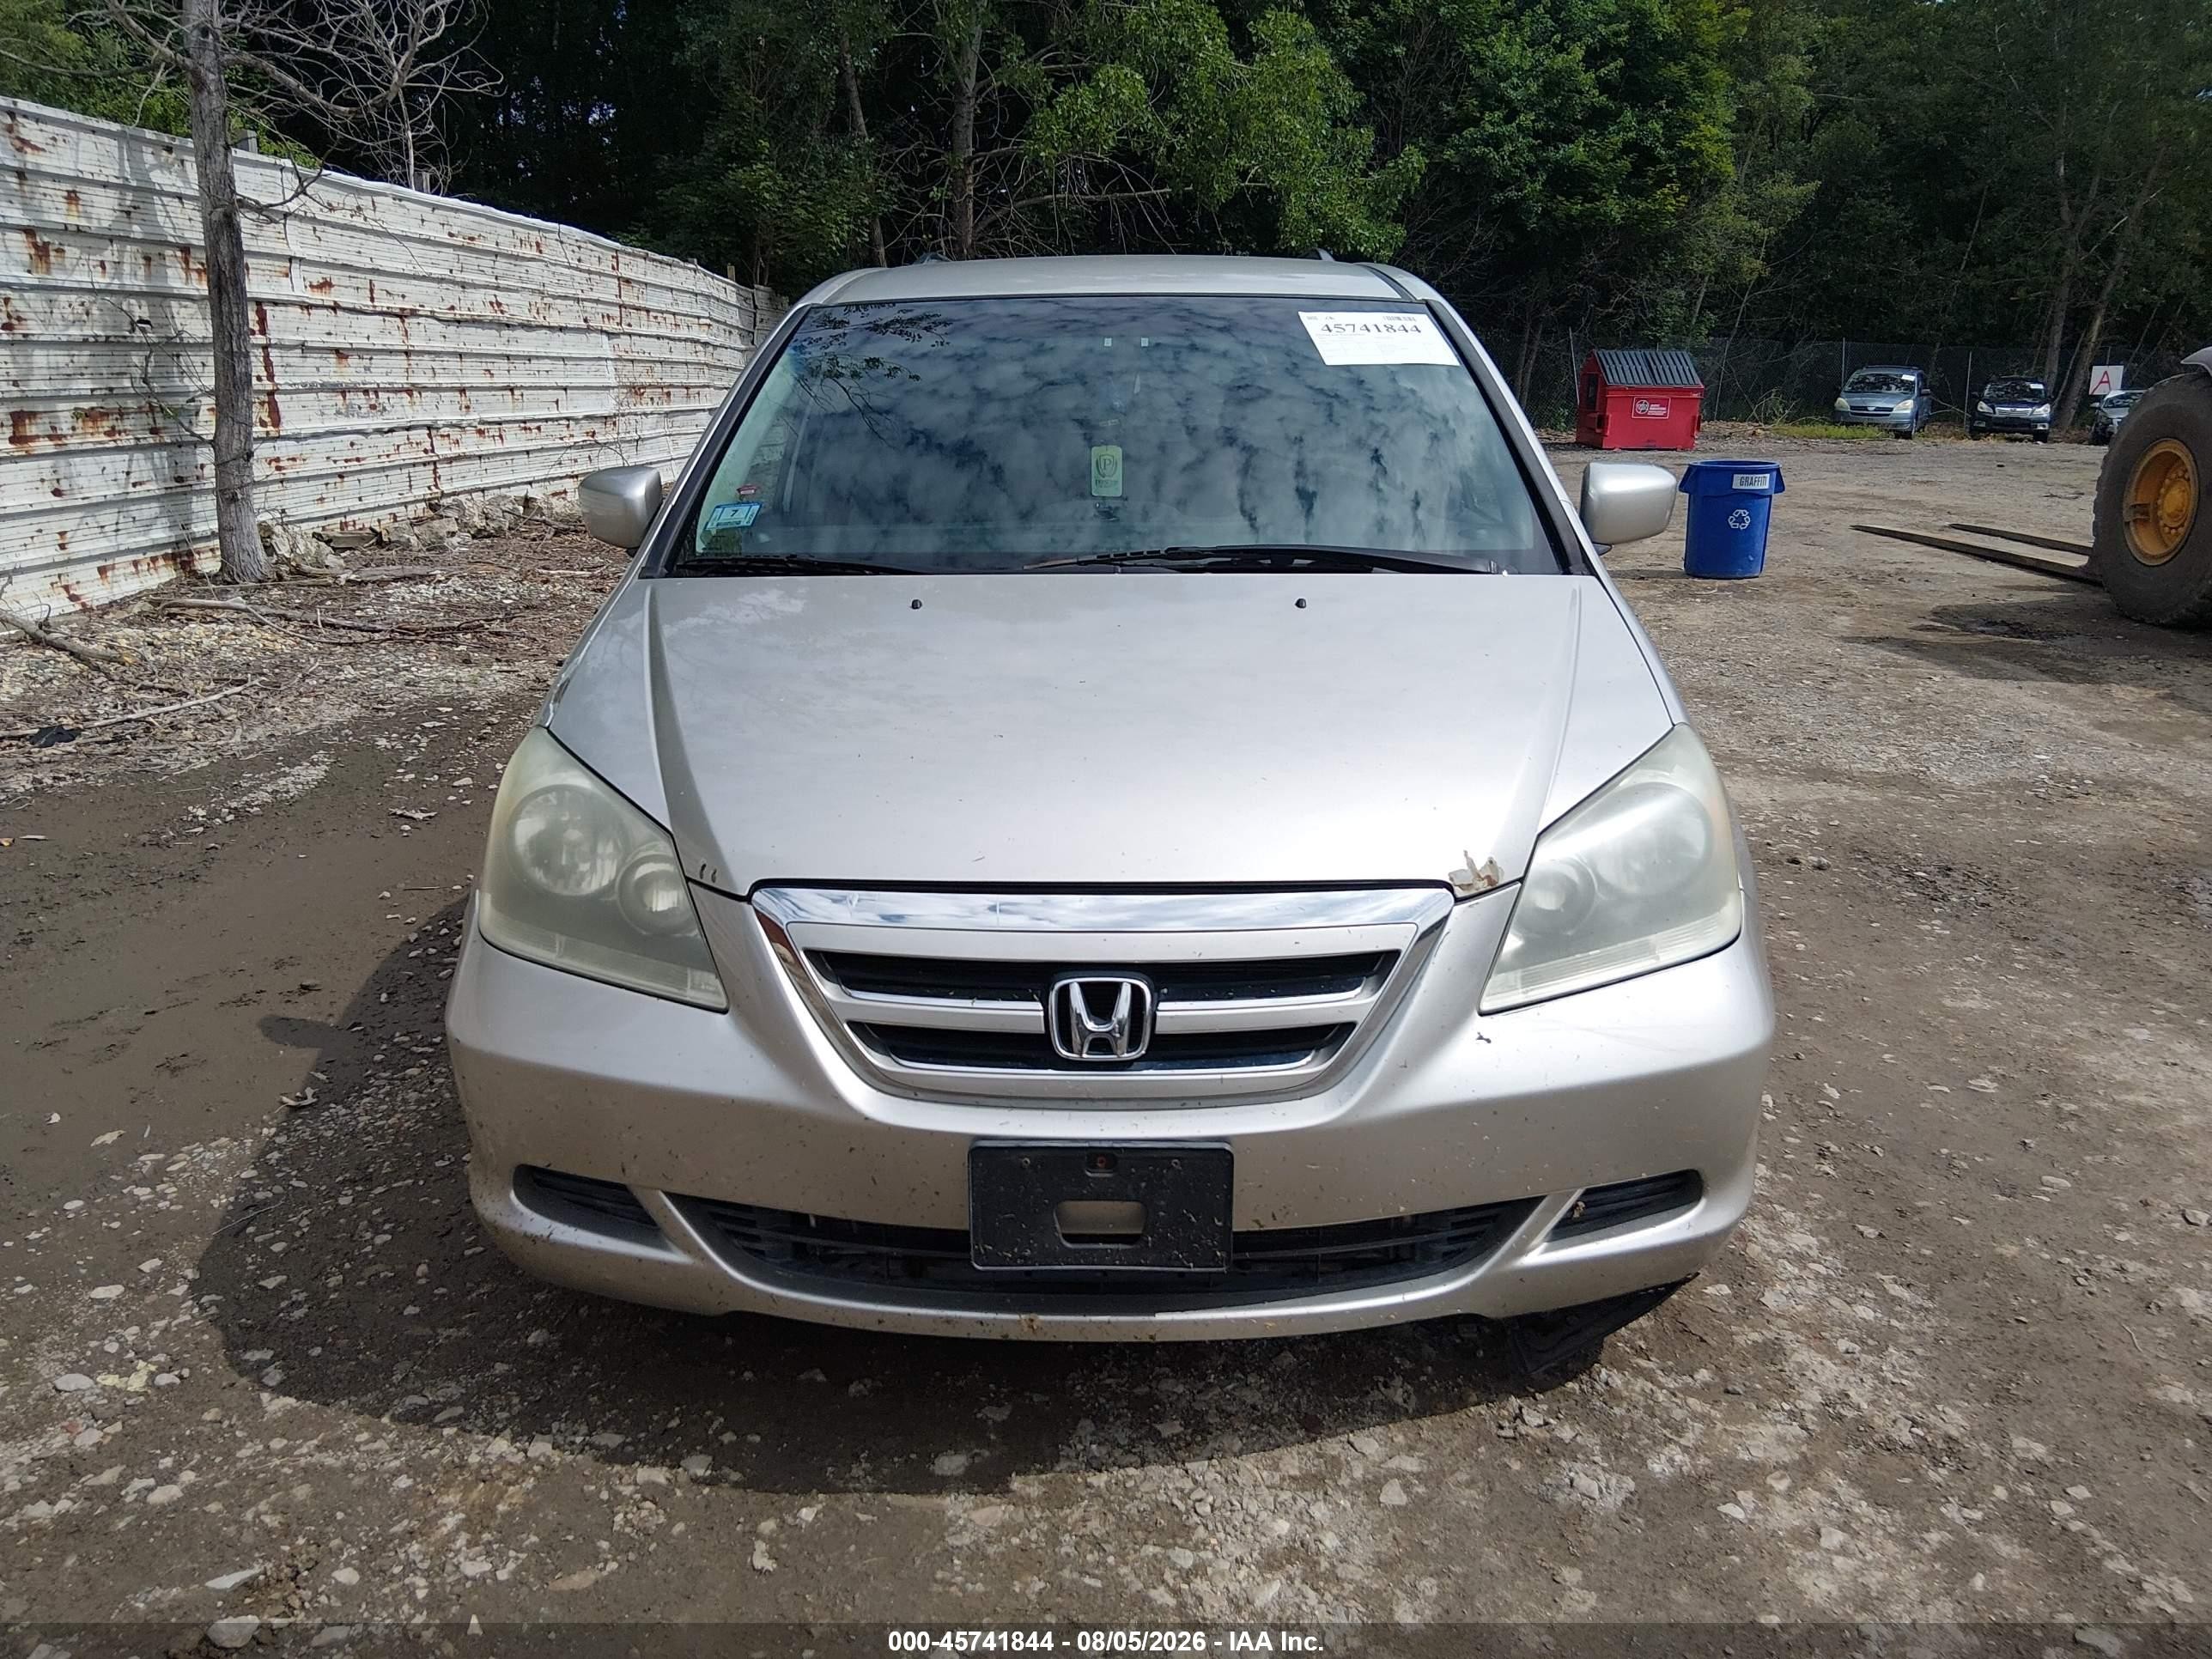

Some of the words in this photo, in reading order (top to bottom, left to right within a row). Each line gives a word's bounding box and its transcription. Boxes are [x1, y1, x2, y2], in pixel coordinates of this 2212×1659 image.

[1321, 323, 1422, 333] 45741844
[2091, 370, 2112, 395] A
[1739, 476, 1767, 487] GRAFFITI
[730, 509, 739, 518] 7
